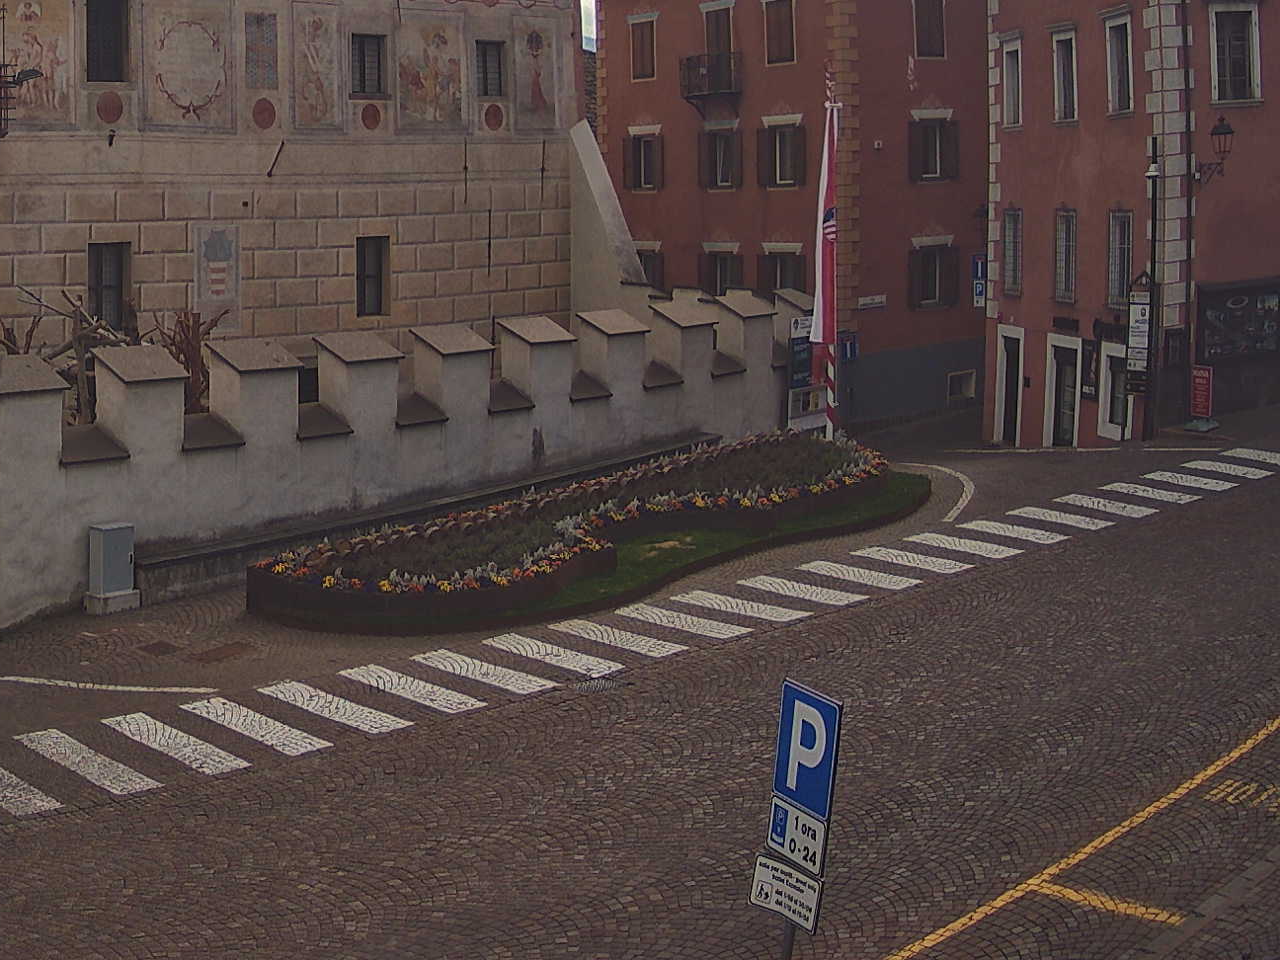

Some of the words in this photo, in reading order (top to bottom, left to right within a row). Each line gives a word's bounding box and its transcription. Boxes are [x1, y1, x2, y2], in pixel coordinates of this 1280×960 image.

[786, 699, 827, 791] P
[794, 815, 800, 831] 1
[801, 823, 817, 842] ora
